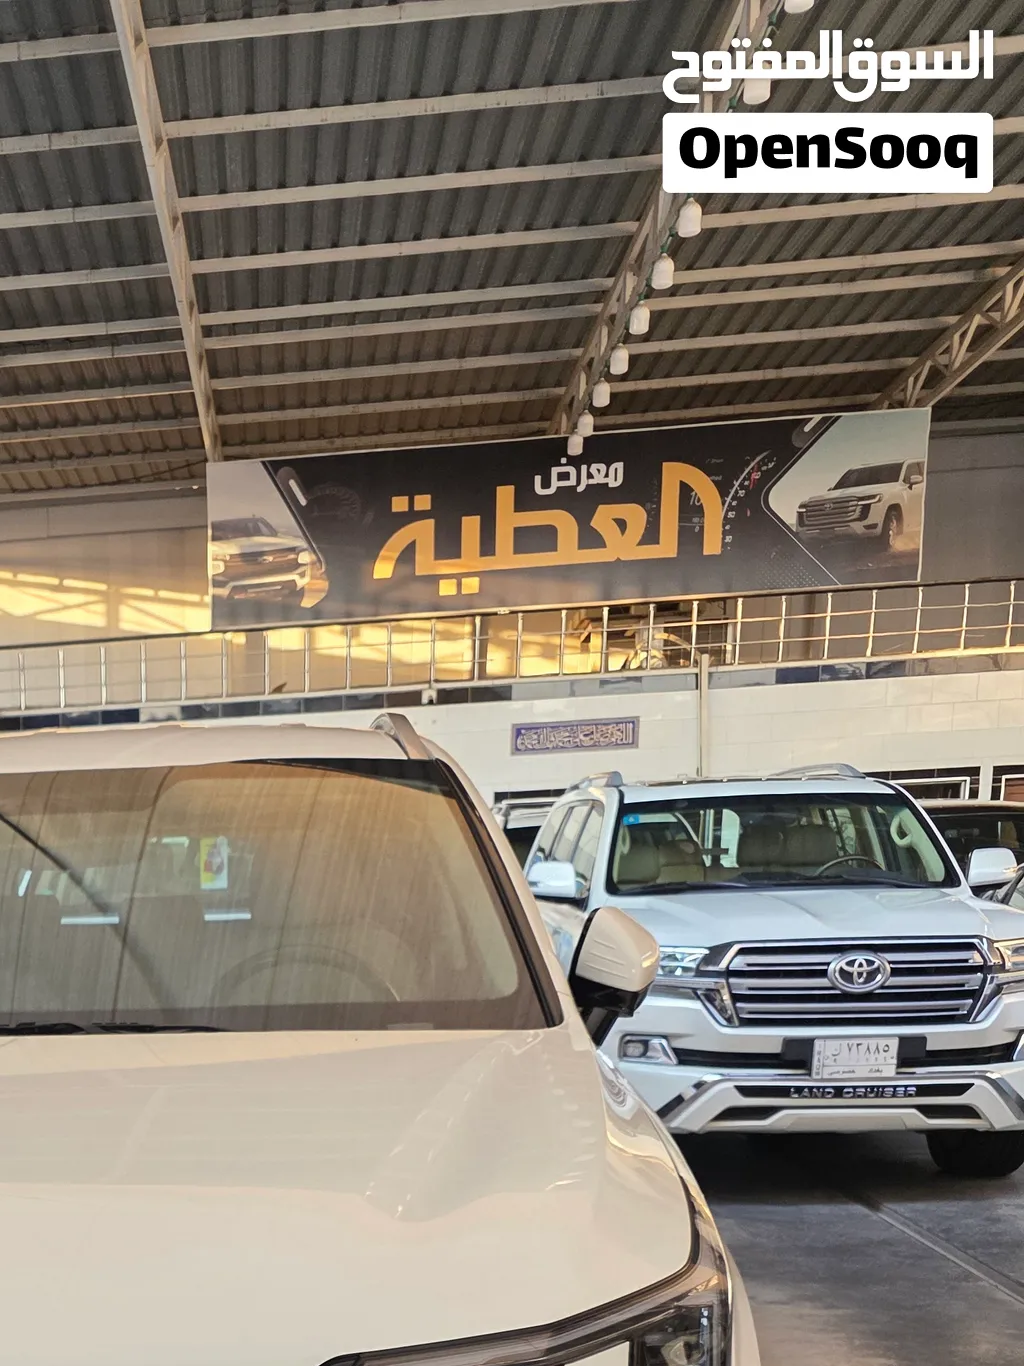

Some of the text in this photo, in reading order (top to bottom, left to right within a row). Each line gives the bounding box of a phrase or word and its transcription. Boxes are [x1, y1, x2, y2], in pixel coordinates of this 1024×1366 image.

[533, 457, 625, 496] معرض
[372, 461, 723, 597] العطية
[789, 1086, 917, 1098] LAND CRUISER
